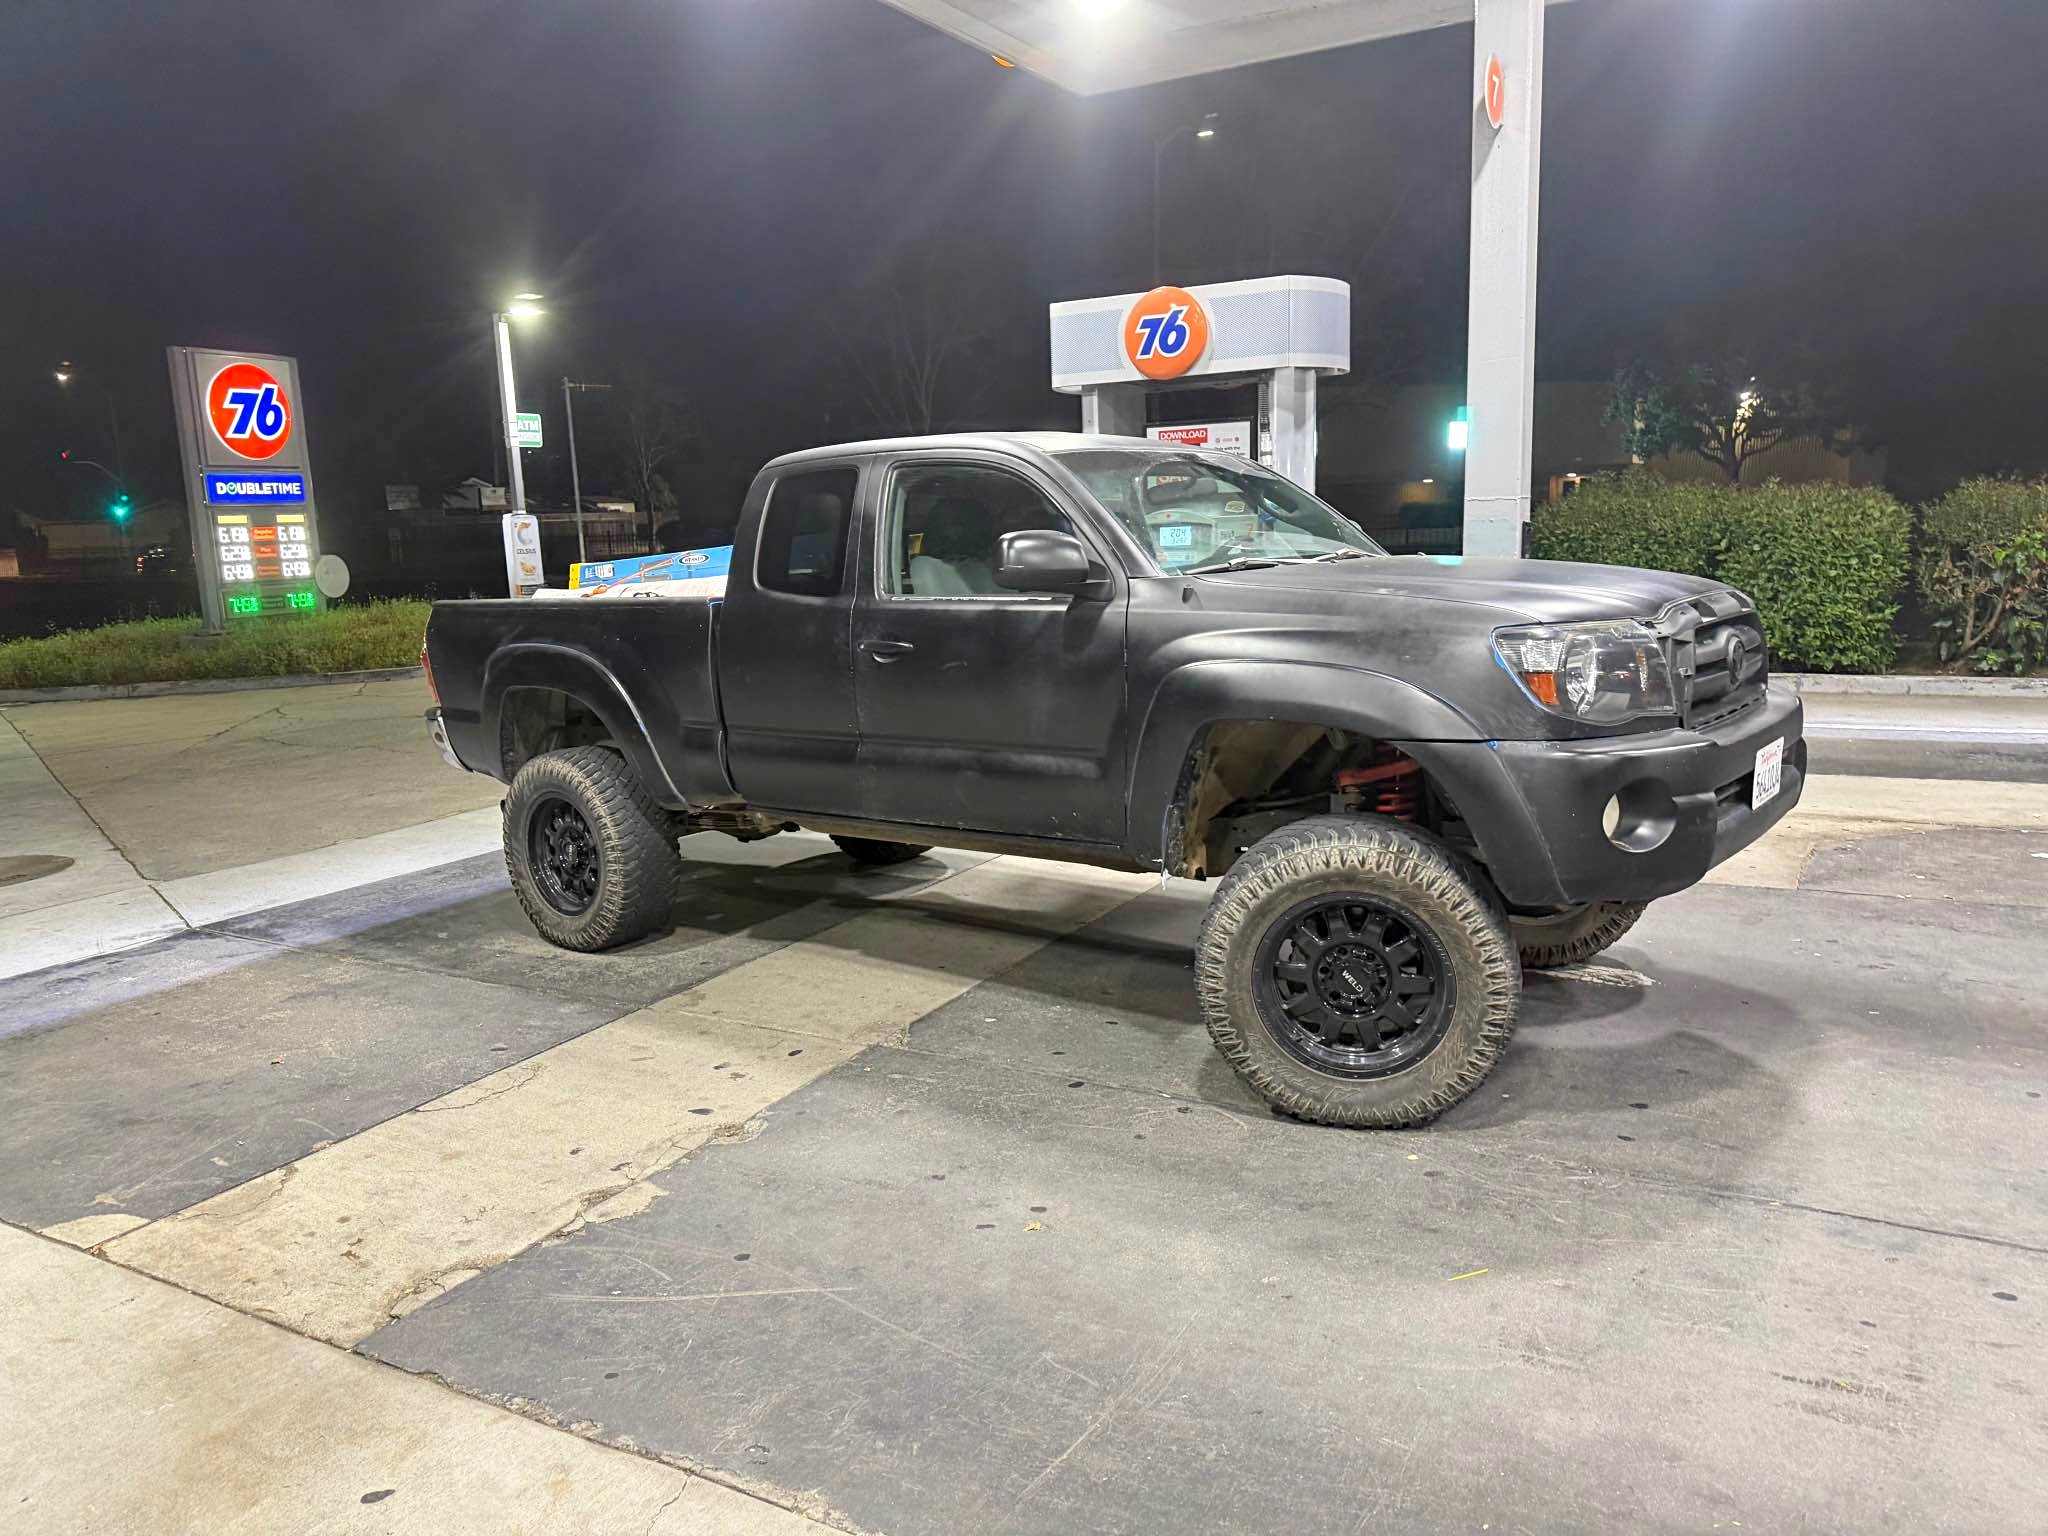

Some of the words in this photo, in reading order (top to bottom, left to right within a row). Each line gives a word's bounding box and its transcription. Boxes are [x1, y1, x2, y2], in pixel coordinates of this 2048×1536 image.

[1135, 303, 1190, 360] 76
[222, 383, 287, 441] 76
[517, 420, 538, 431] ATM
[1160, 430, 1206, 440] DOWNLOAD
[216, 481, 302, 496] DOUBLETIME
[1342, 970, 1364, 992] WELD
